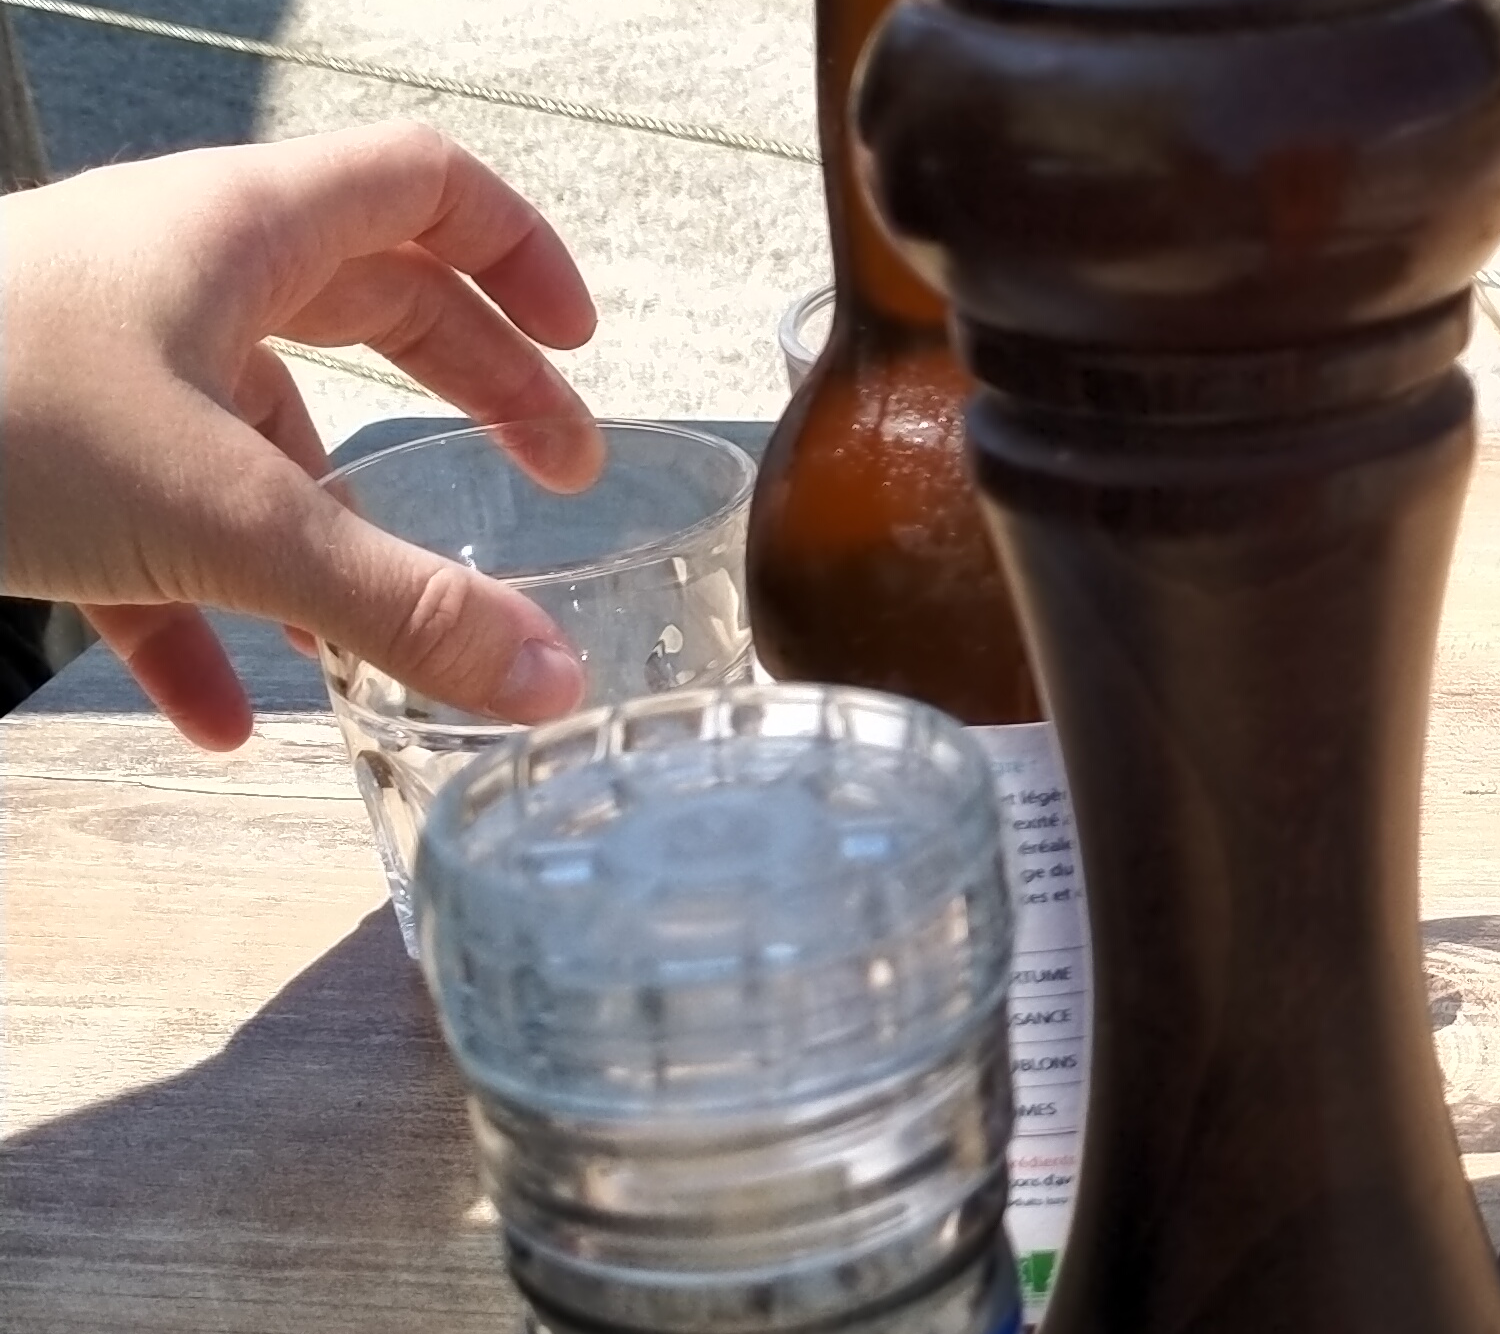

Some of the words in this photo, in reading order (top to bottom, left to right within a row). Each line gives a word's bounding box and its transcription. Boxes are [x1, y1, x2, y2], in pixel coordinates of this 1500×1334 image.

[1020, 868, 1046, 883] ge
[1050, 863, 1074, 877] du
[1012, 1008, 1072, 1025] SANCE
[1016, 1102, 1058, 1116] MES
